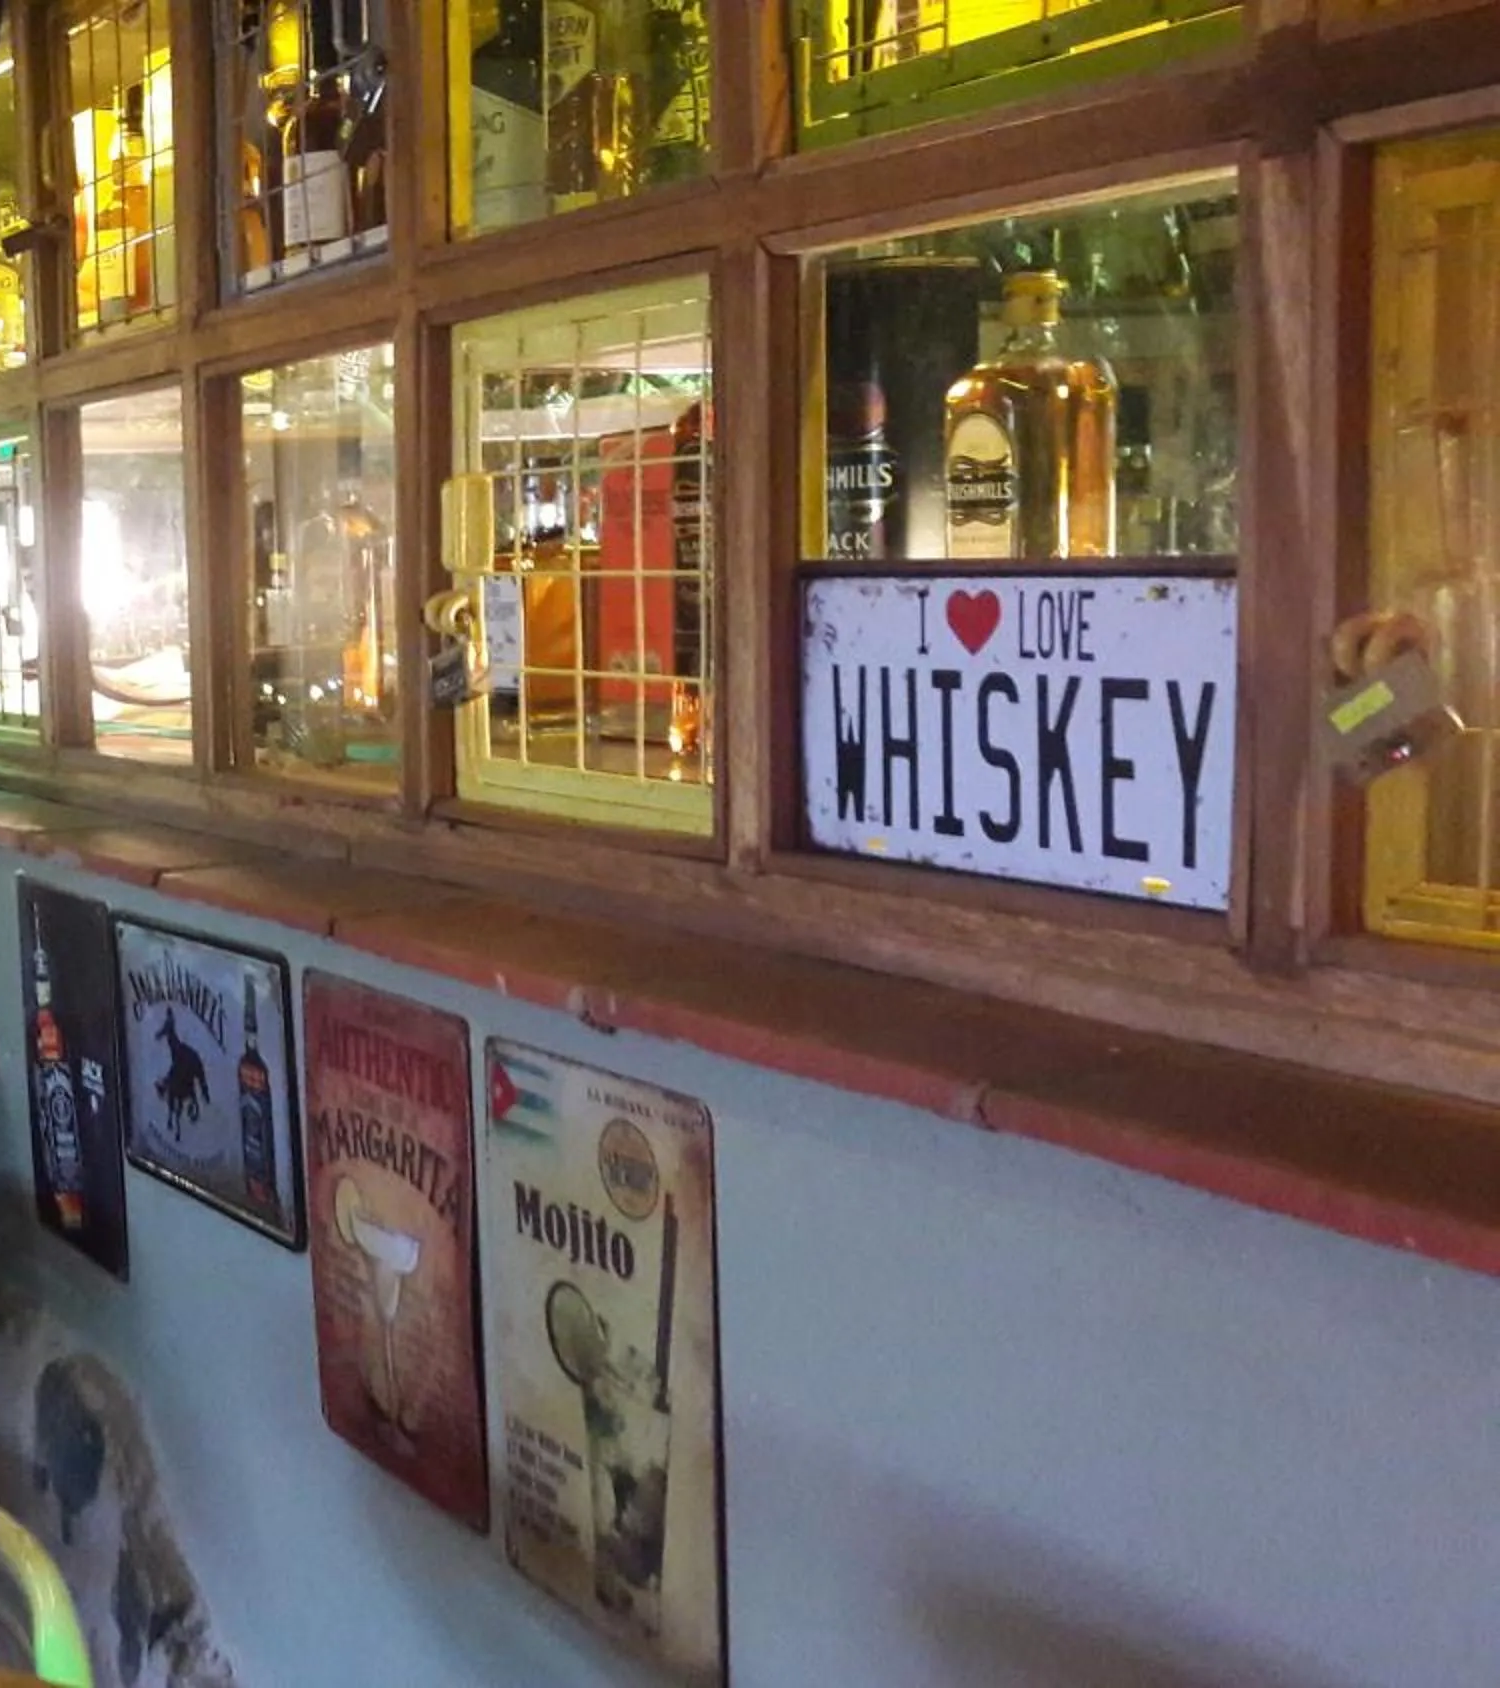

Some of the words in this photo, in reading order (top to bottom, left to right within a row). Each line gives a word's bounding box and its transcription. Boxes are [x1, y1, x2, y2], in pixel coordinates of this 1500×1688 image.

[826, 463, 893, 490] HMILLS
[828, 531, 870, 551] ACK
[917, 588, 930, 655] I
[1018, 590, 1096, 662] LOVE
[832, 663, 1217, 869] WHISKEY
[312, 1107, 464, 1228] MARGARITA
[513, 1179, 635, 1282] Mojito
